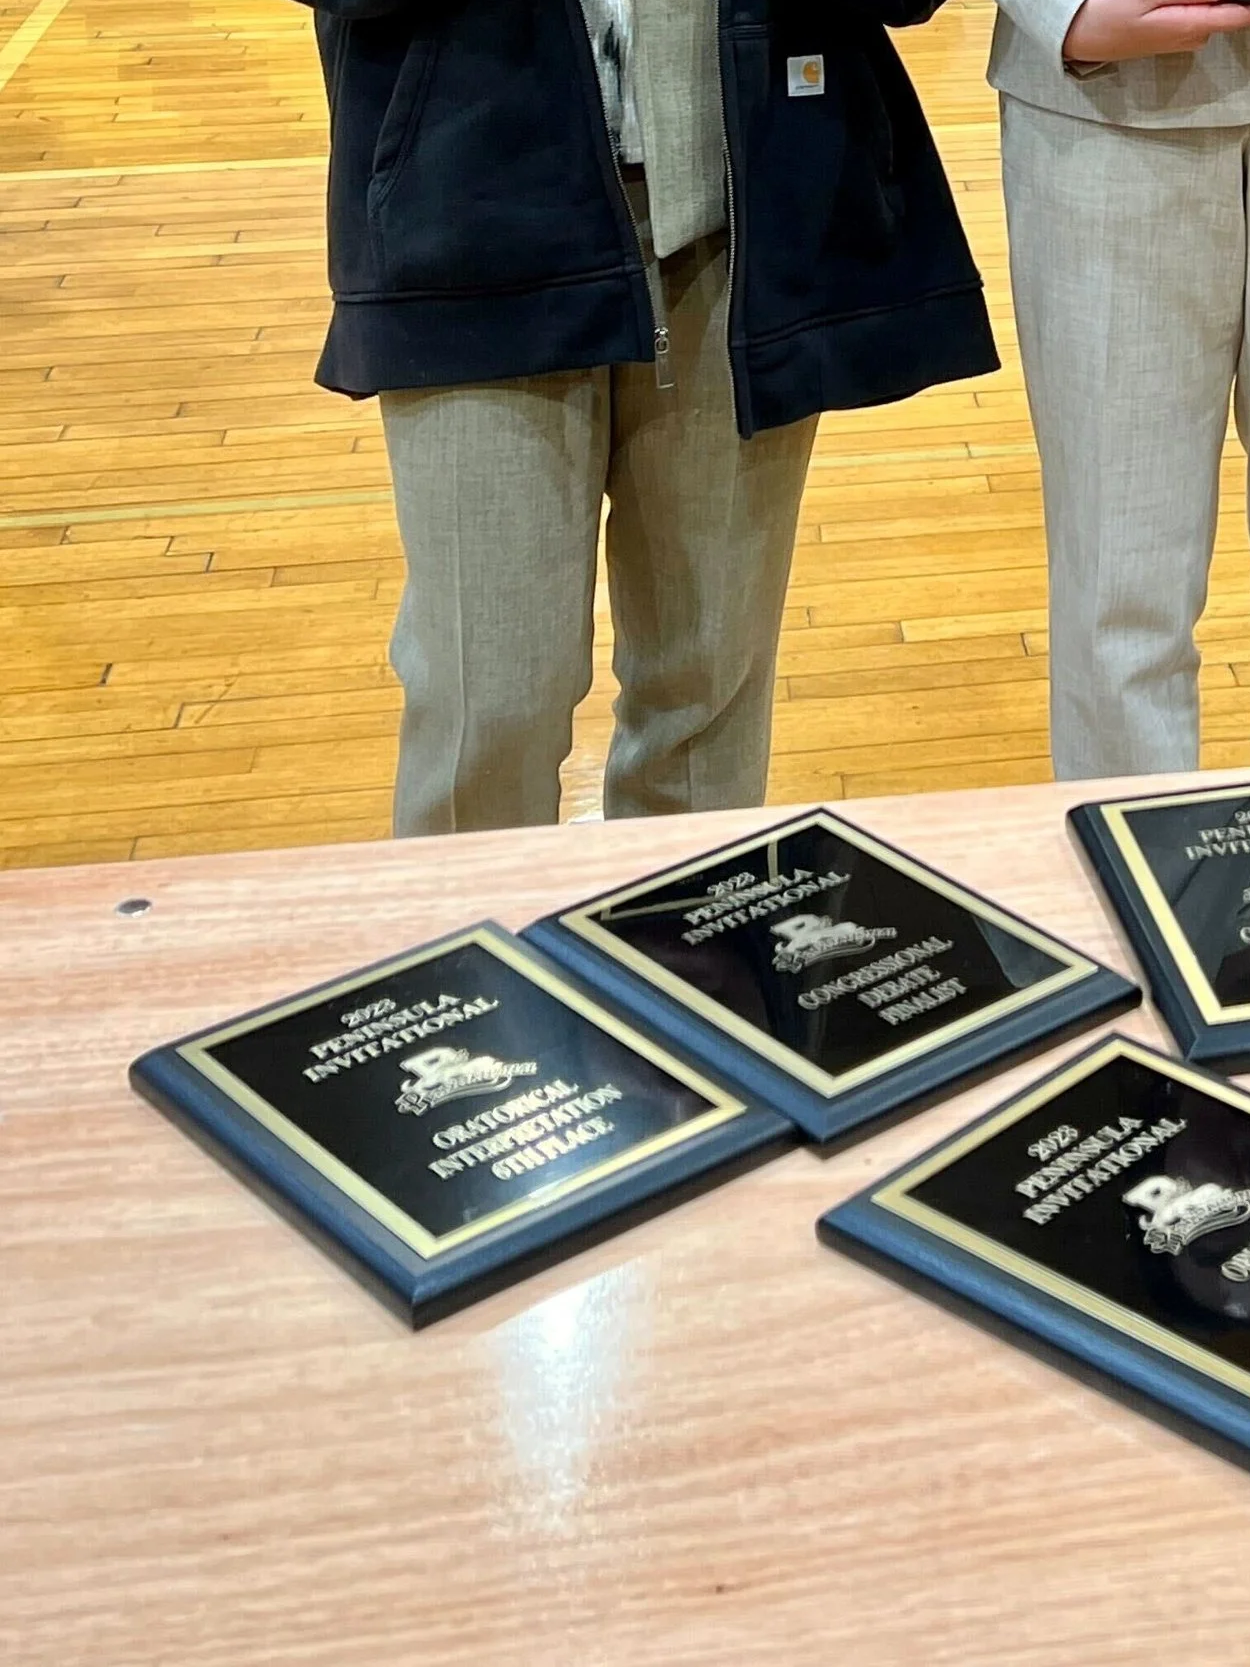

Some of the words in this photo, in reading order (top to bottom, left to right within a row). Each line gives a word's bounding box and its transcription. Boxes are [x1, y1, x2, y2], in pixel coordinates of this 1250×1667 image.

[680, 871, 851, 946] INVITATIONAL
[683, 868, 814, 925] PENINSULA
[798, 936, 954, 1010] CONGRESSIONAL
[858, 965, 941, 1008] DEBATE
[878, 977, 967, 1025] FINALIST
[302, 996, 500, 1083] INVITATIONAL
[309, 994, 463, 1060] PENINSULA
[341, 999, 396, 1028] 2023
[428, 1084, 624, 1180] INTERPRETATION
[432, 1079, 579, 1150] ORATORICAL
[534, 1117, 615, 1169] PLACE
[1027, 1125, 1078, 1161] 2023
[1015, 1116, 1143, 1199] PENINSULA
[1022, 1117, 1188, 1225] INVITATIONAL
